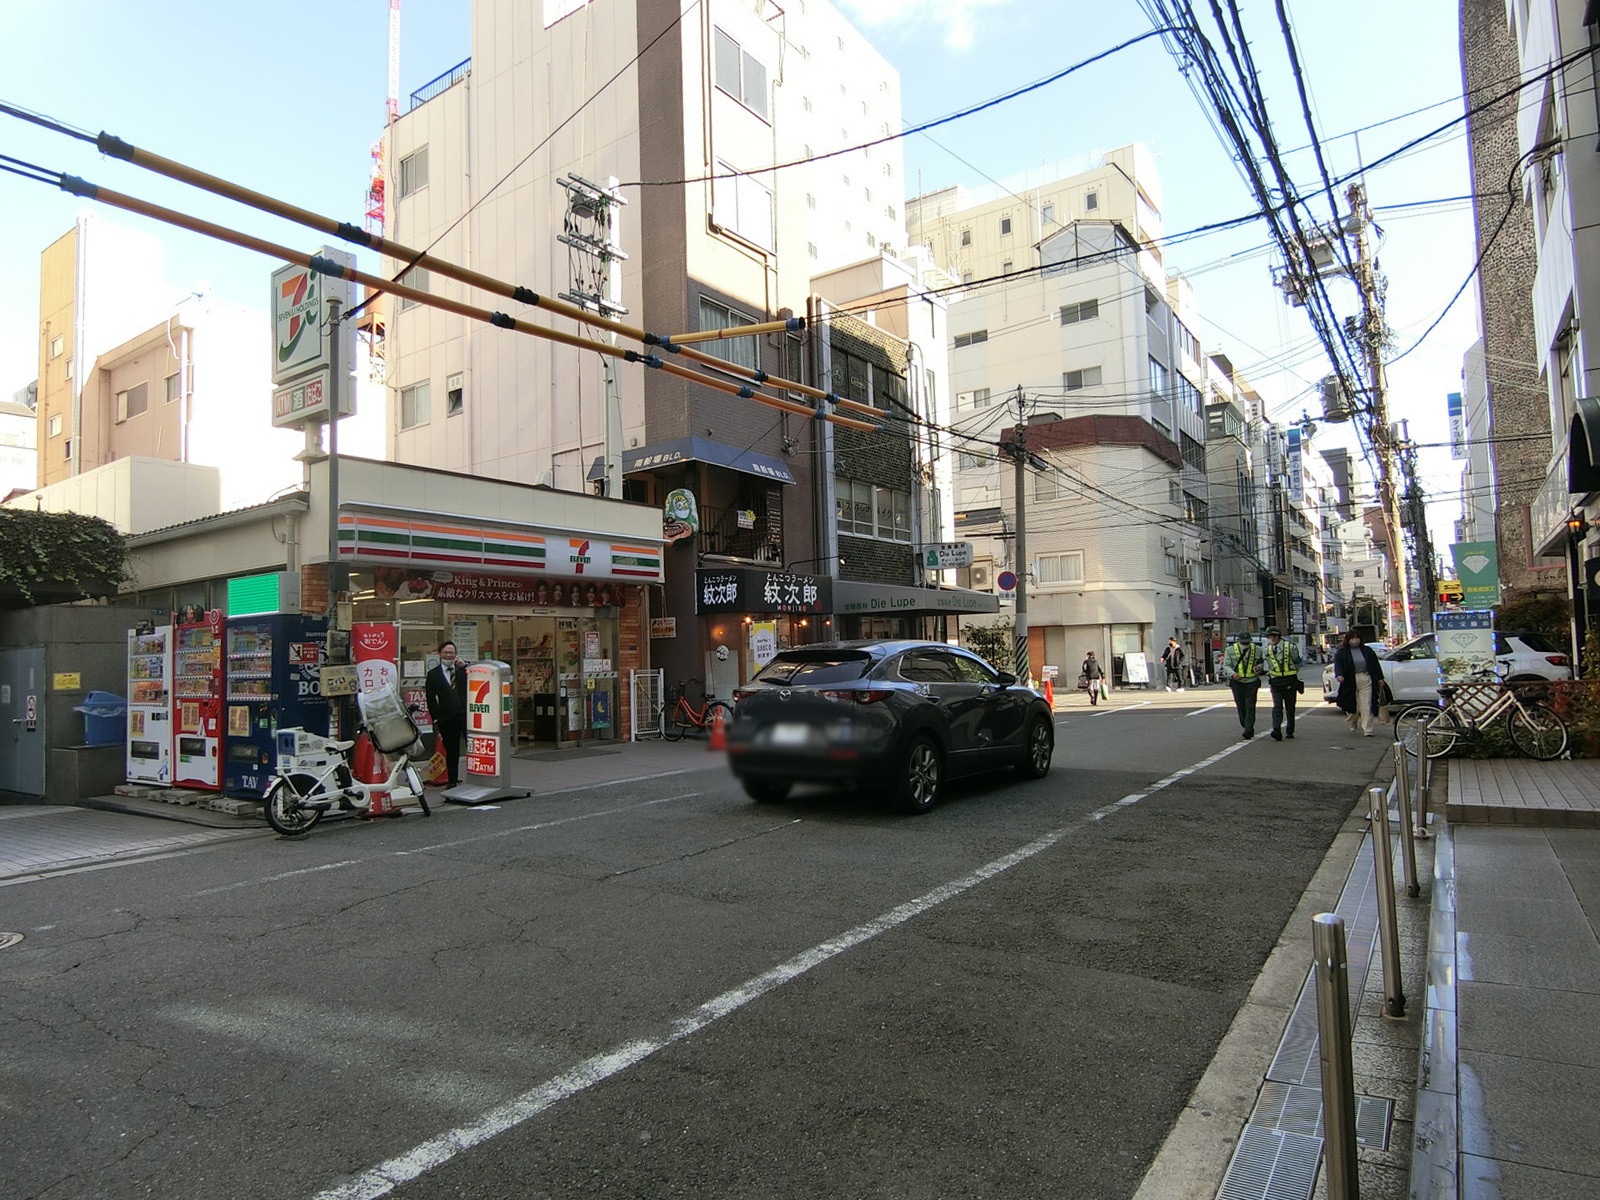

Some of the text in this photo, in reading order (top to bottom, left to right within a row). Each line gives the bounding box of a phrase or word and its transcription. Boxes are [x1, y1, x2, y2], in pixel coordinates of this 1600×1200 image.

[276, 394, 291, 417] ATM
[940, 550, 950, 558] Die
[454, 576, 478, 588] King
[479, 578, 486, 587] &
[704, 575, 737, 584] とんこつラーメン
[766, 572, 815, 585] とんこつラーメン
[703, 582, 738, 606] 紋次郎
[763, 581, 818, 606] 紋次郎
[870, 598, 887, 609] Die
[890, 597, 916, 609] Lupe
[952, 595, 961, 607] Die
[473, 738, 495, 756] たばこ
